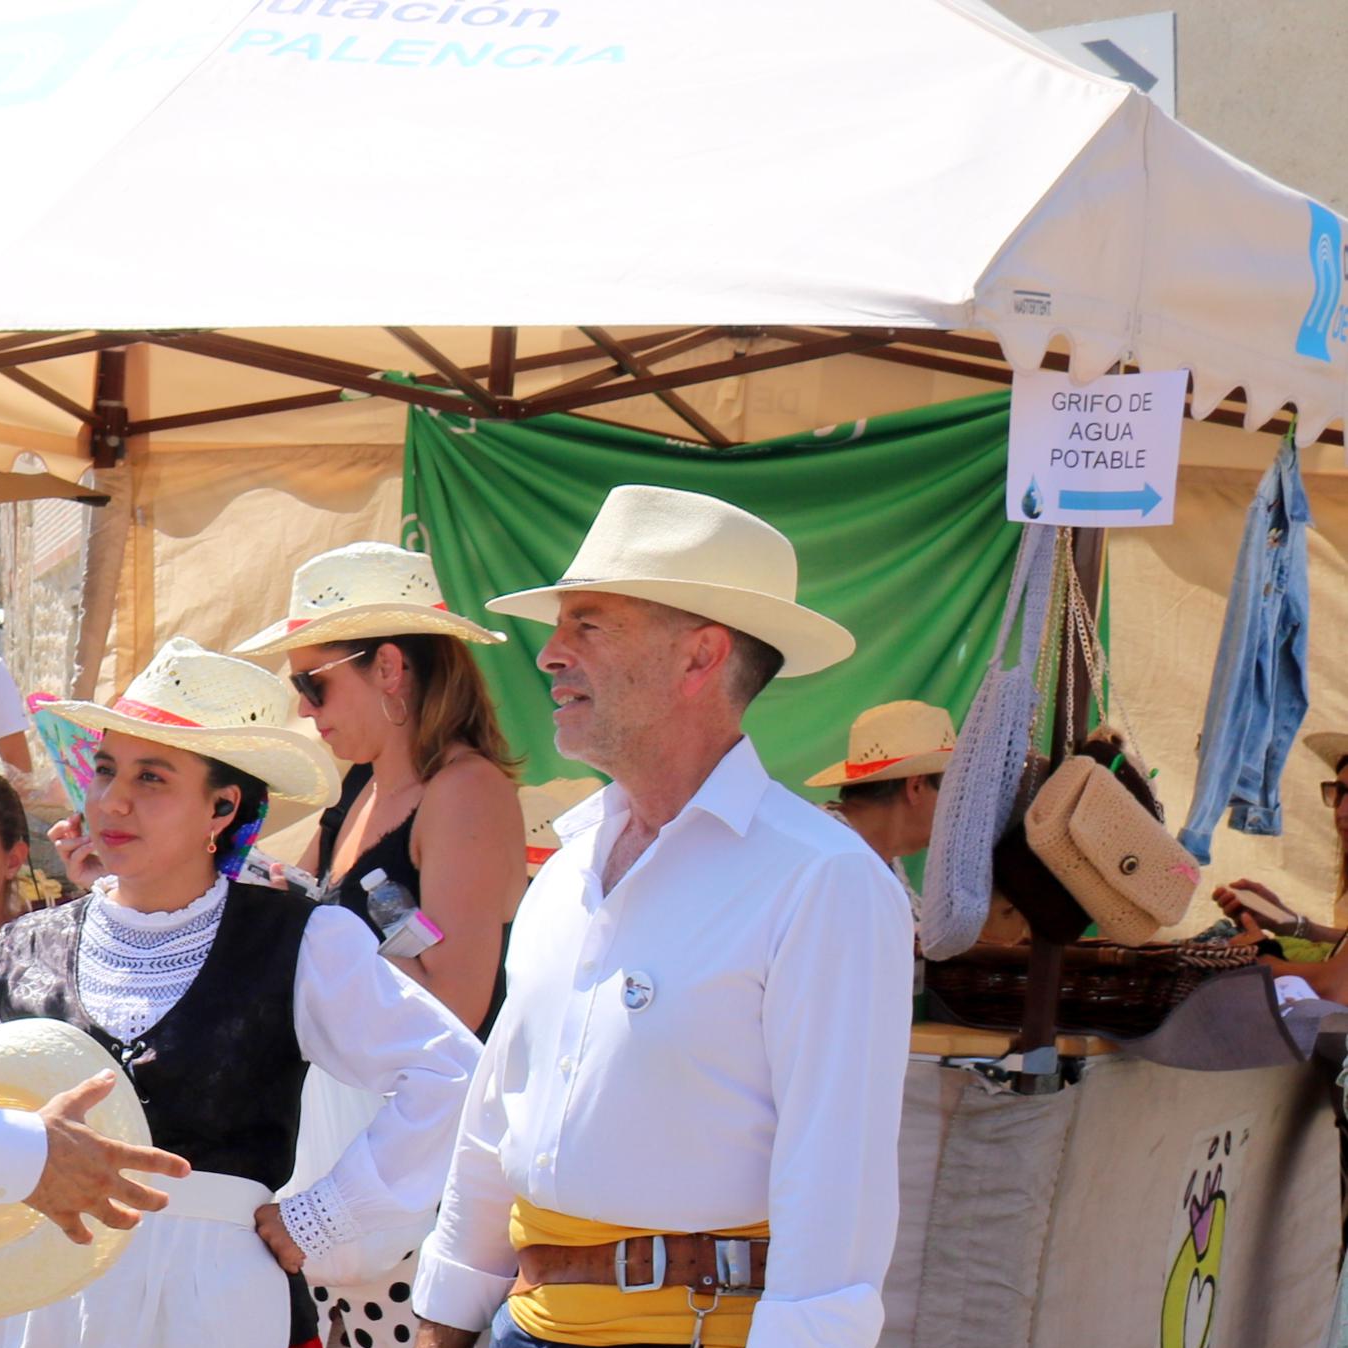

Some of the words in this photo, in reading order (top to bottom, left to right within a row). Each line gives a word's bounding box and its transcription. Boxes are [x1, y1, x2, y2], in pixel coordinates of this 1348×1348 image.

[266, 0, 561, 28] utación
[226, 29, 628, 69] PALENCIA
[1051, 392, 1122, 413] GRIFO
[1129, 392, 1153, 412] DE
[1068, 422, 1134, 441] AGUA
[1049, 448, 1146, 469] POTABLE
